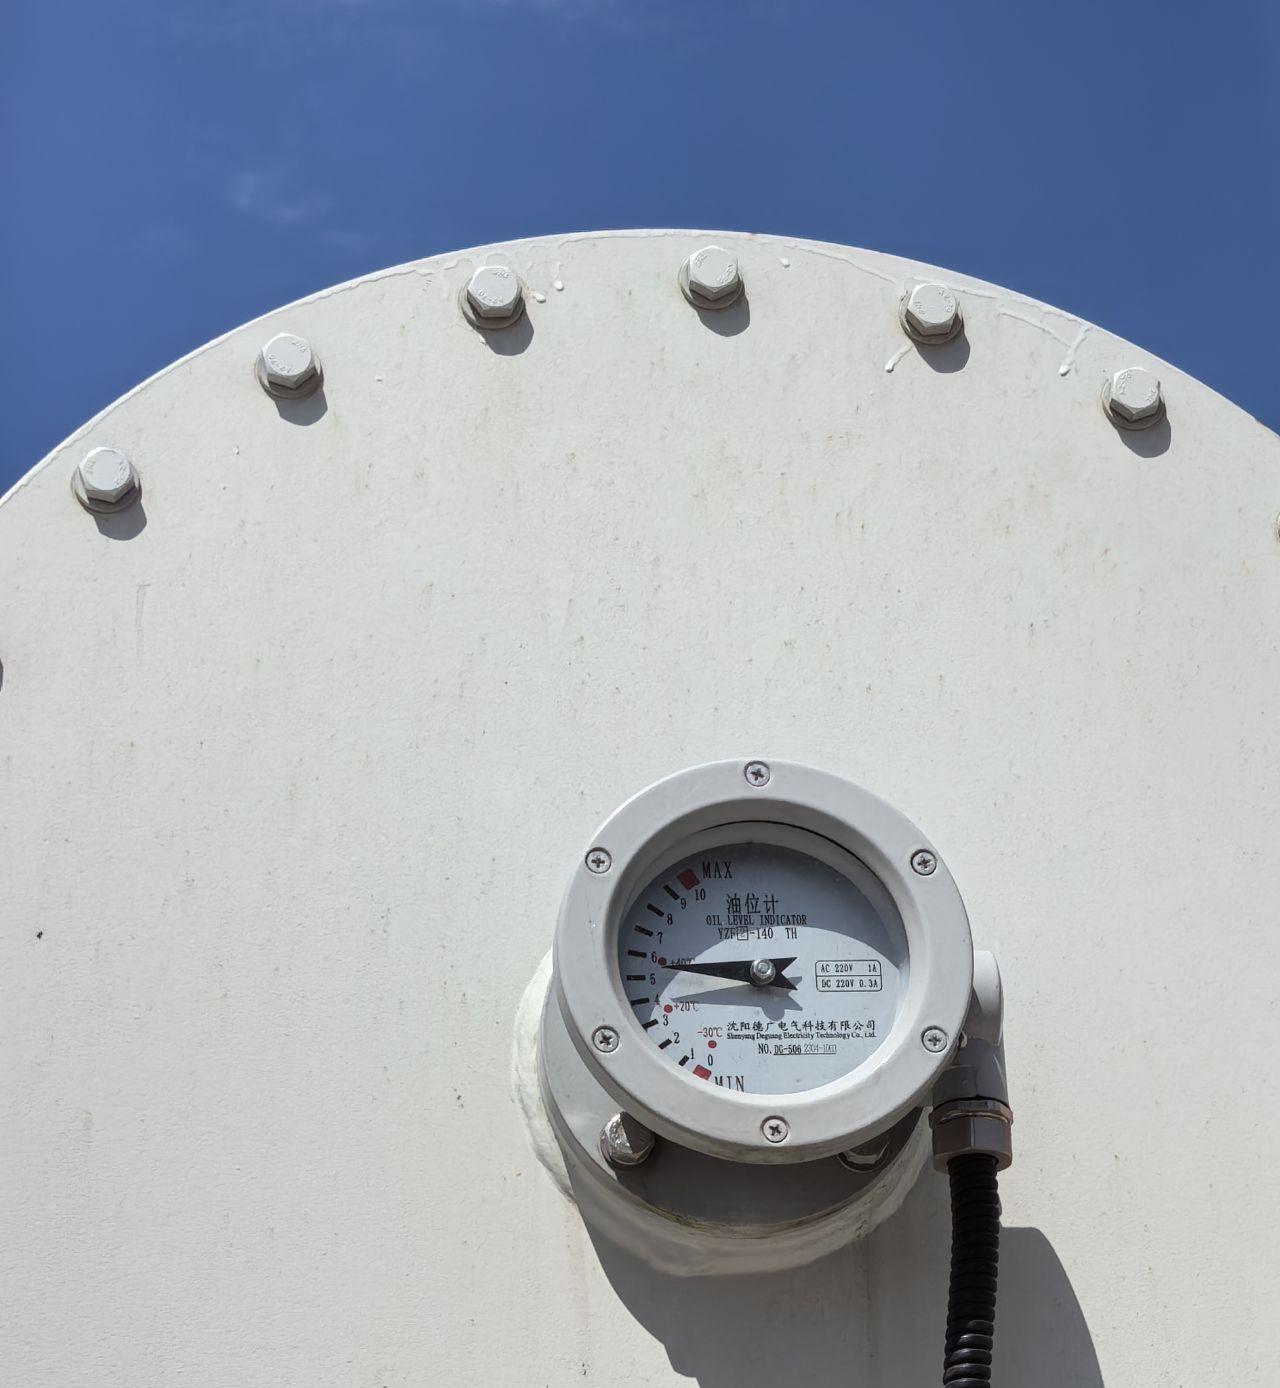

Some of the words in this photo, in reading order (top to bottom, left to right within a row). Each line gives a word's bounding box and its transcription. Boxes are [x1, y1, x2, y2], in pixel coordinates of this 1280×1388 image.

[702, 861, 733, 879] MAX
[695, 888, 706, 901] 10
[680, 897, 687, 910] 9
[726, 893, 779, 914] 油位计
[666, 913, 673, 926] 8
[706, 914, 722, 926] OIL
[728, 914, 755, 926] LEVEL
[760, 914, 807, 926] INDICATOR
[657, 931, 663, 945] 7
[785, 927, 797, 940] TH
[651, 951, 658, 964] 6
[821, 963, 830, 973] AC
[834, 963, 853, 973] 220V
[868, 963, 877, 973] 1A
[649, 972, 656, 985] 5
[821, 979, 831, 988] DC
[836, 979, 854, 988] 220V
[654, 991, 661, 1005] 4
[662, 1014, 669, 1027] 3
[727, 1019, 876, 1032] 沈阳德广电气科技有限公司
[673, 1031, 680, 1044] 2
[690, 1047, 695, 1060] 1
[758, 1043, 772, 1055] NO.
[707, 1054, 714, 1067] 0
[714, 1075, 744, 1093] MIN
